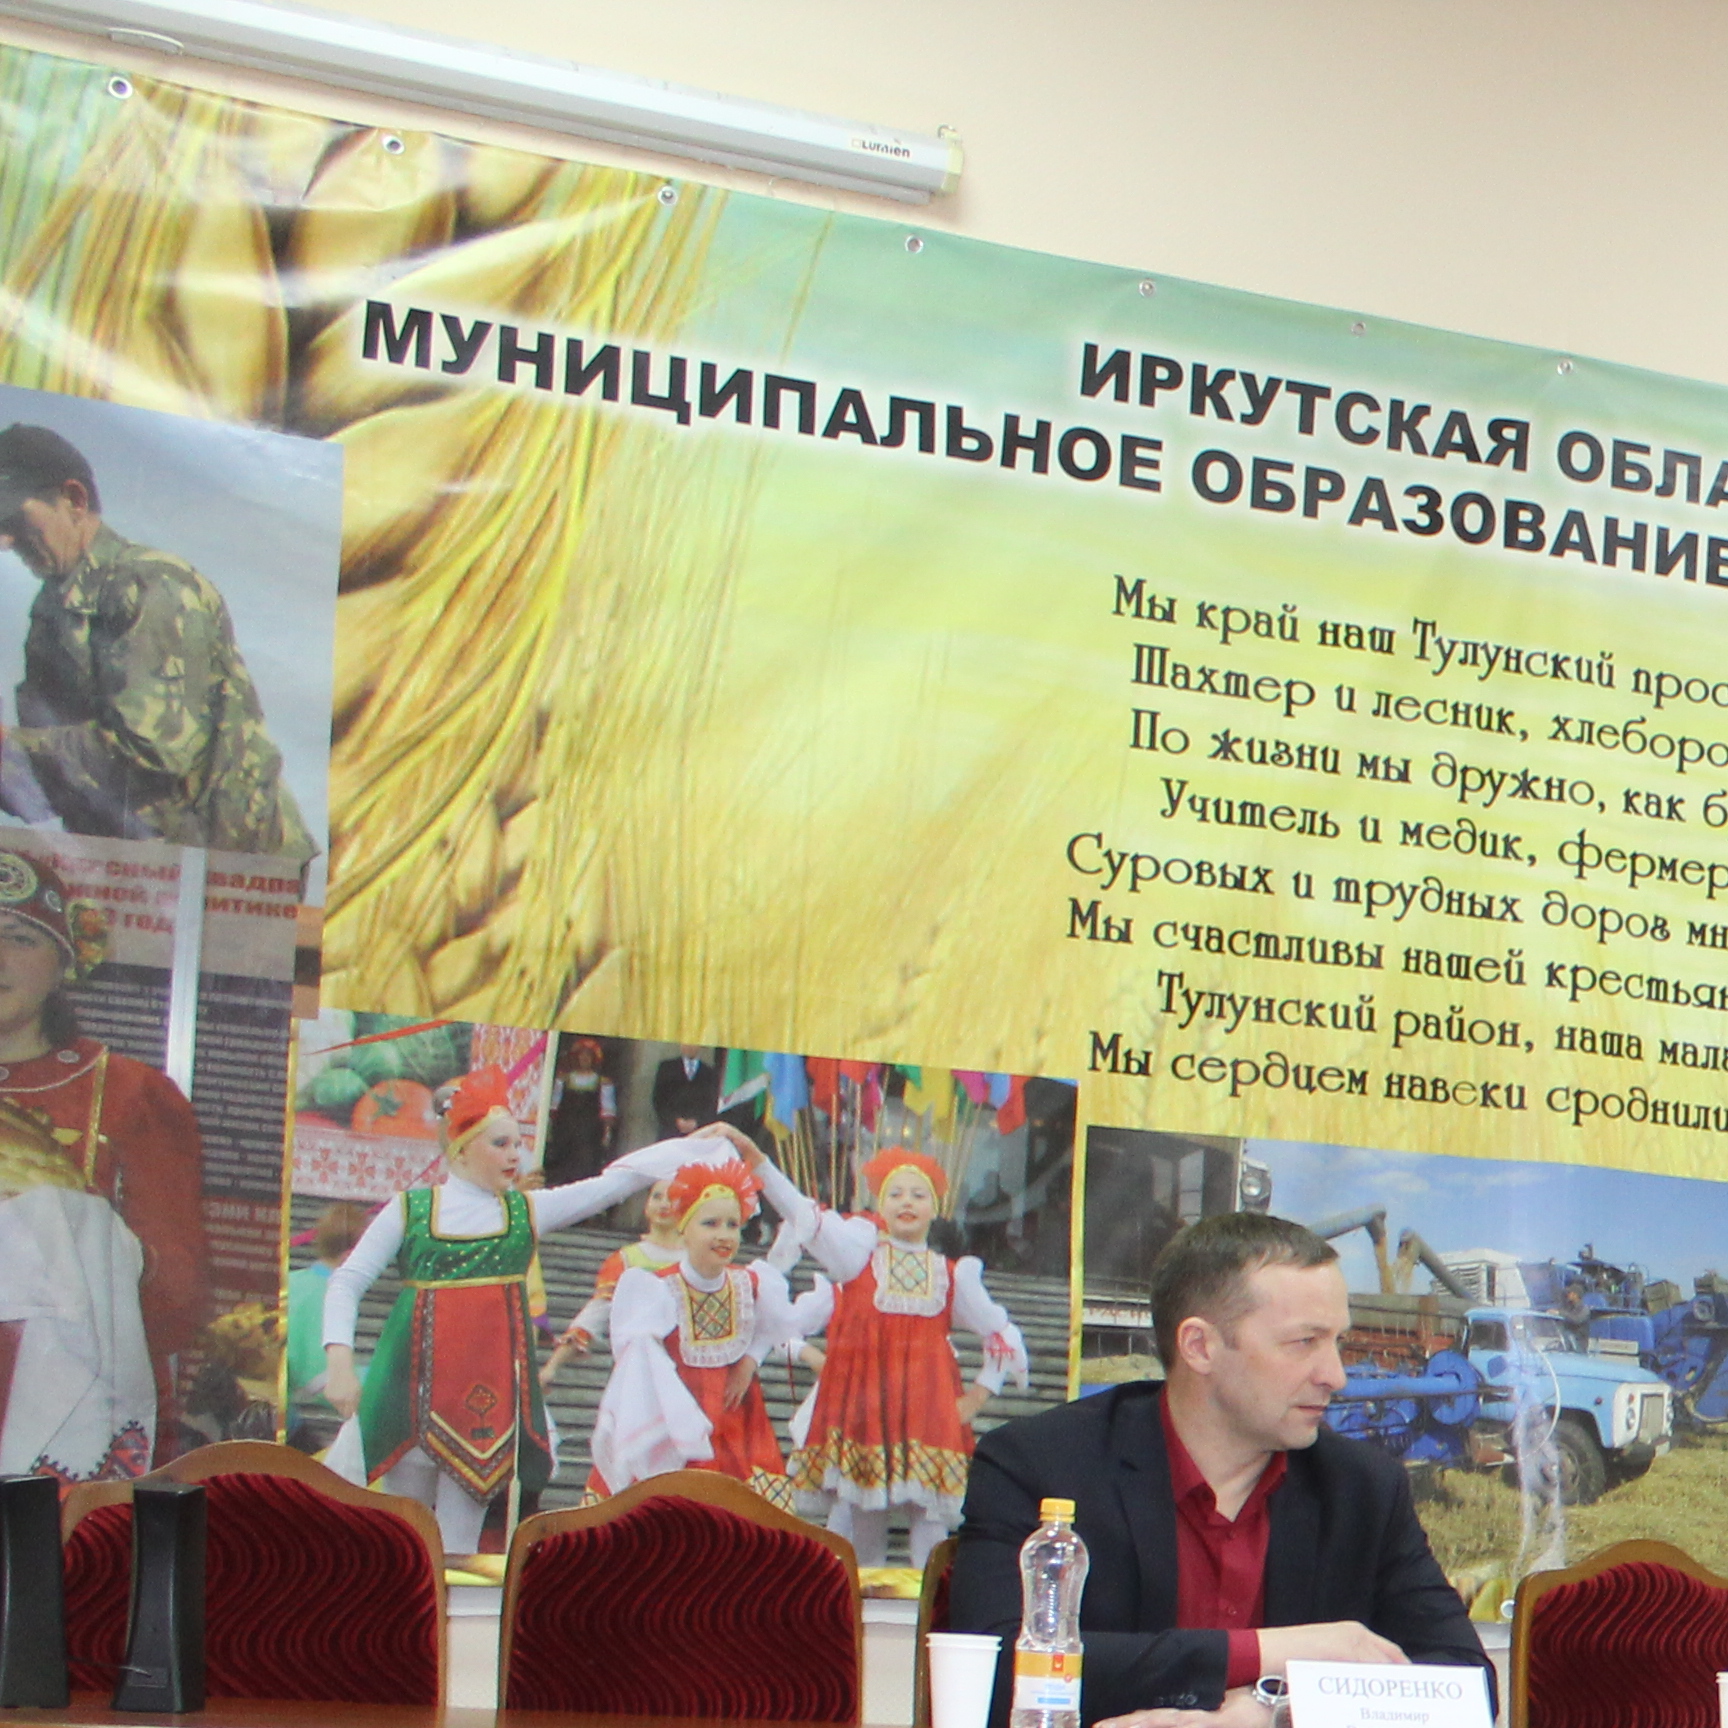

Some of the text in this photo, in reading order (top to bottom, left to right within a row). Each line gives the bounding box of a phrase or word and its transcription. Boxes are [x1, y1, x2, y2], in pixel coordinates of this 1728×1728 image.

[360, 298, 1164, 495] МУНИЦИПАЛЬНОЕ
[1078, 341, 1532, 473] ИРКУТСКАЯ
[1112, 574, 1177, 624] Мы
[1196, 602, 1300, 644] край
[1318, 618, 1395, 655] наш
[1413, 617, 1616, 690] Тулунский
[1131, 643, 1316, 717] Шахтер
[1334, 683, 1357, 713] и
[1371, 689, 1529, 743] лесник,
[1129, 708, 1190, 754] По
[1208, 728, 1341, 775] жизни
[1356, 753, 1413, 784] мы
[1431, 751, 1606, 814] дружно,
[1621, 787, 1686, 824] как
[1160, 777, 1340, 839] Учитель
[1358, 813, 1383, 845] и
[1400, 818, 1537, 867] медик,
[1065, 832, 1275, 895] Суровых
[1293, 871, 1315, 900] и
[1334, 875, 1524, 923] трудных
[1541, 891, 1671, 944] дорог
[1065, 897, 1134, 944] Мы
[1153, 919, 1385, 970] счастливы
[1402, 945, 1527, 987] нашей
[1157, 968, 1378, 1035] Тулунский
[1393, 1004, 1535, 1054] район,
[1555, 1023, 1644, 1062] наша
[1087, 1030, 1154, 1077] Мы
[1171, 1051, 1370, 1098] сердцем
[1384, 1071, 1529, 1111] навеки
[1319, 1677, 1462, 1699] СИДОРЕНКО
[1361, 1708, 1429, 1724] Владимир
